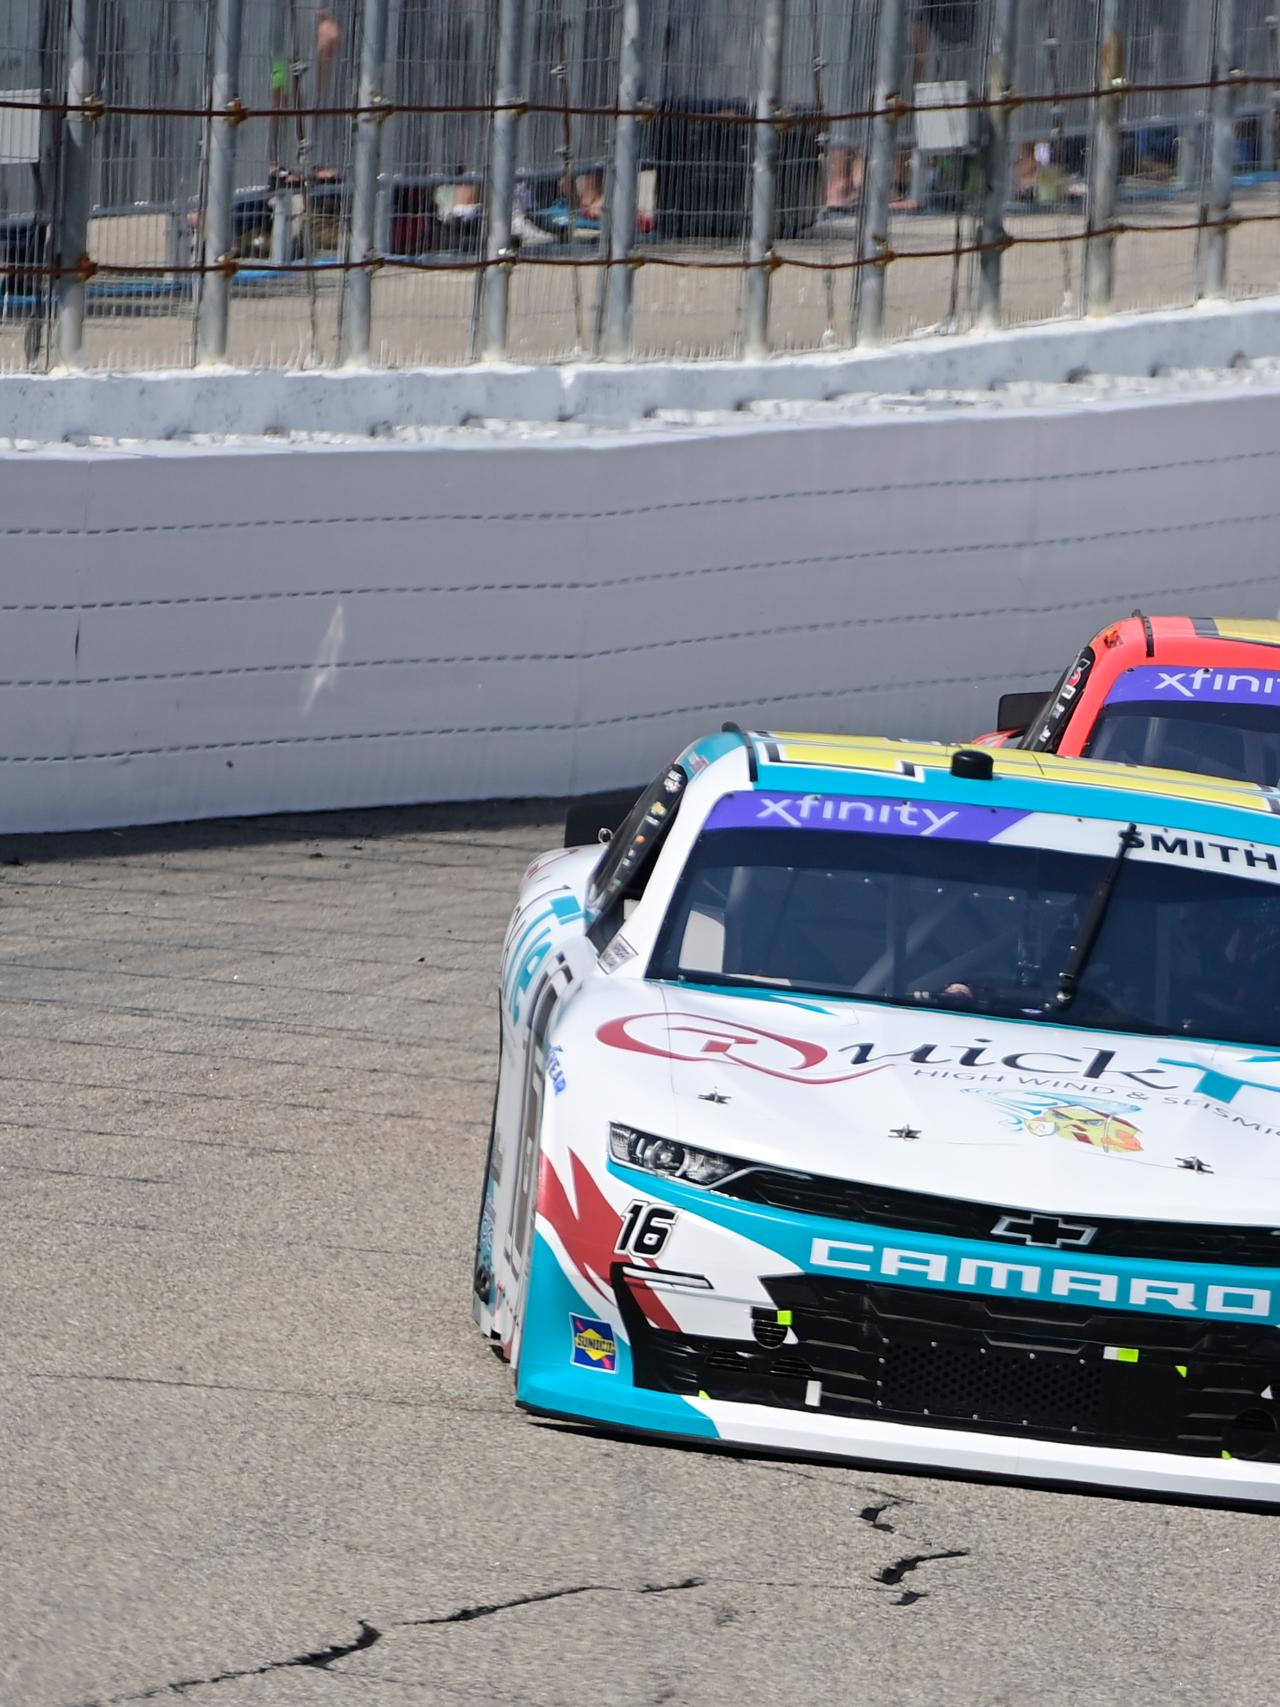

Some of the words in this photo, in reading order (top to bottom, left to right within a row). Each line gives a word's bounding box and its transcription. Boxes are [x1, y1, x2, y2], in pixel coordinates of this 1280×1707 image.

[756, 794, 960, 836] xfinity
[1118, 828, 1278, 871] SMITH
[913, 1068, 1005, 1083] HIGH
[1018, 1076, 1116, 1095] WIND
[614, 1199, 681, 1259] 16
[808, 1237, 1271, 1317] CAMARO
